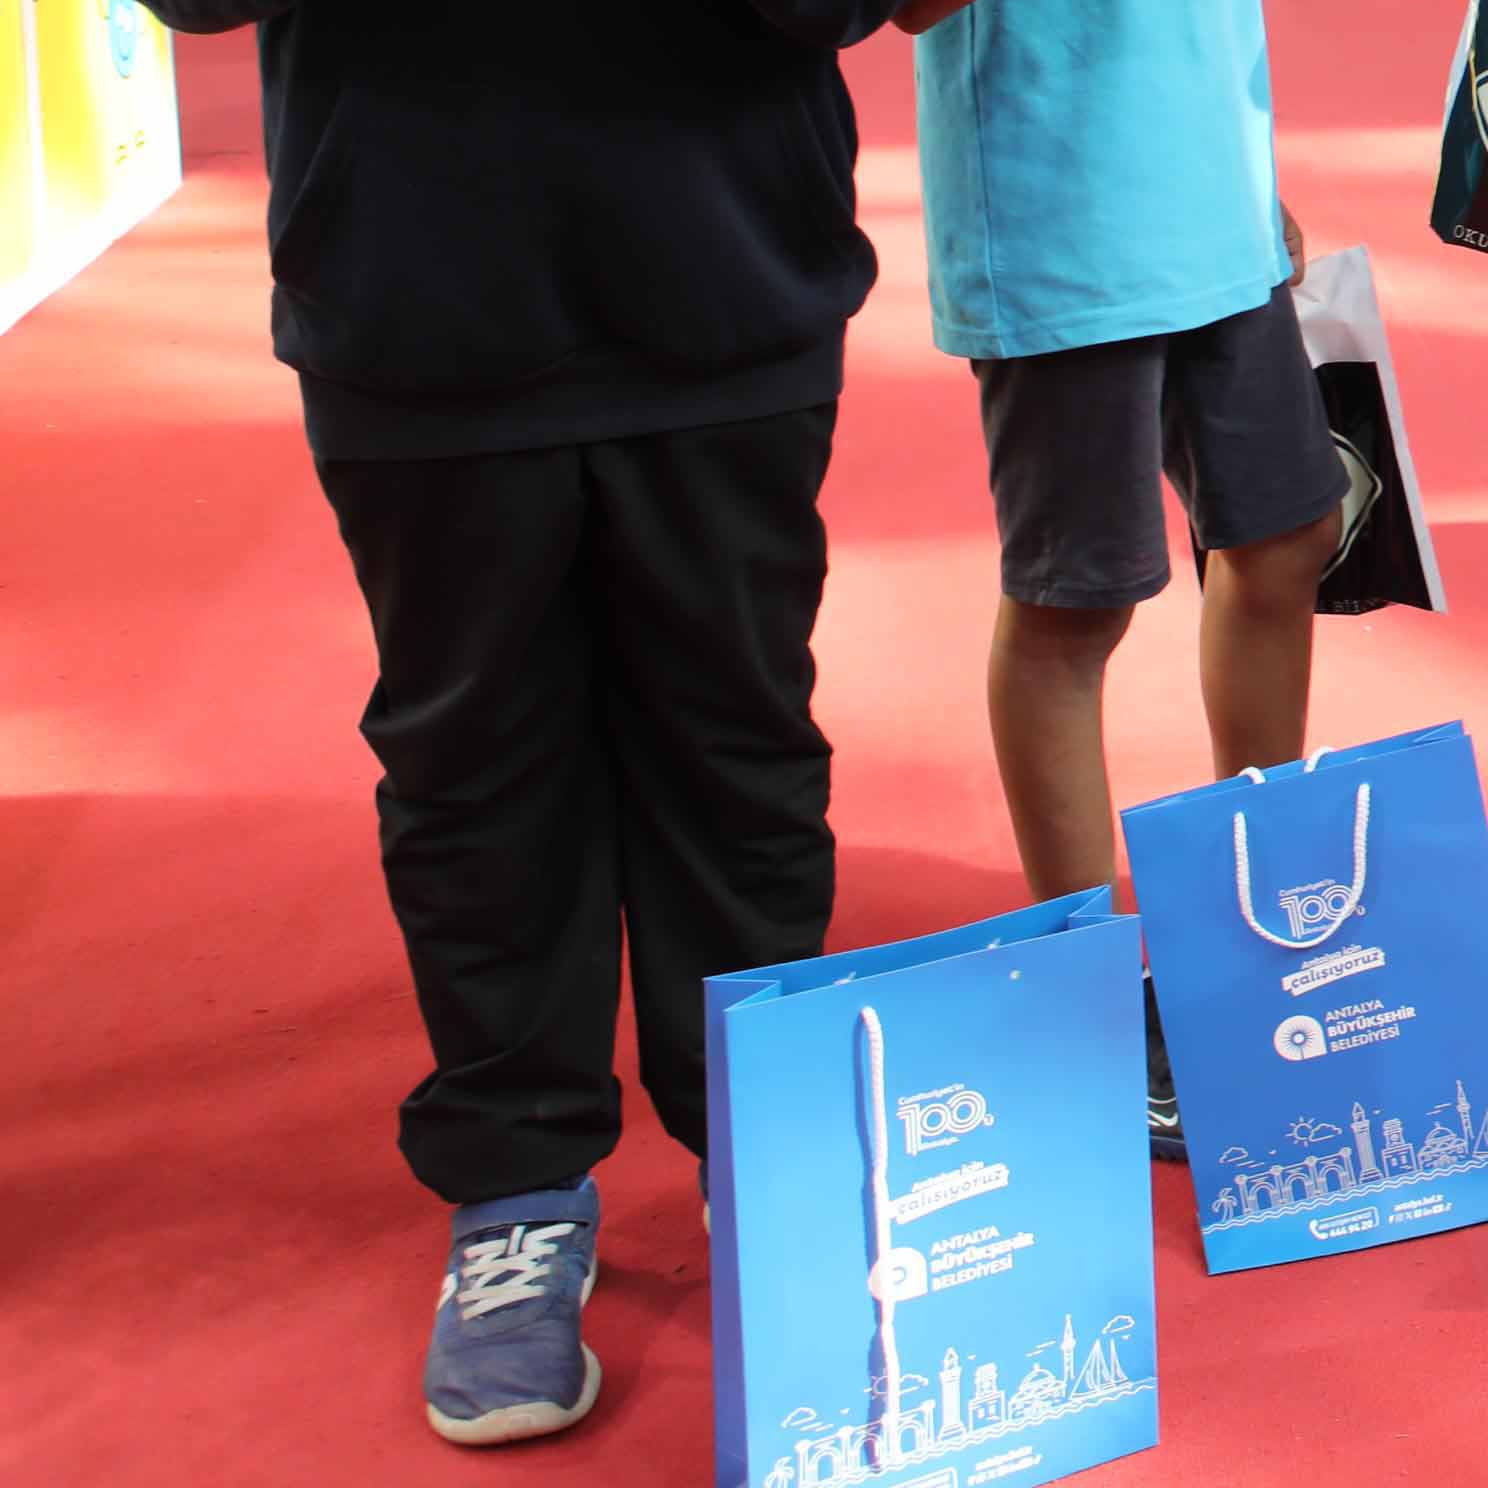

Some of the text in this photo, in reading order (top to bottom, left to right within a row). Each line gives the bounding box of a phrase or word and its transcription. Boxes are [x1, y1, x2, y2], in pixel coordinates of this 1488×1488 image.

[1325, 999, 1384, 1022] ANTALYA
[1327, 1006, 1416, 1037] BÜYÜKŞEHİR
[1330, 1023, 1401, 1053] BELEDİYESİ
[931, 1225, 1000, 1256] ANTALYA
